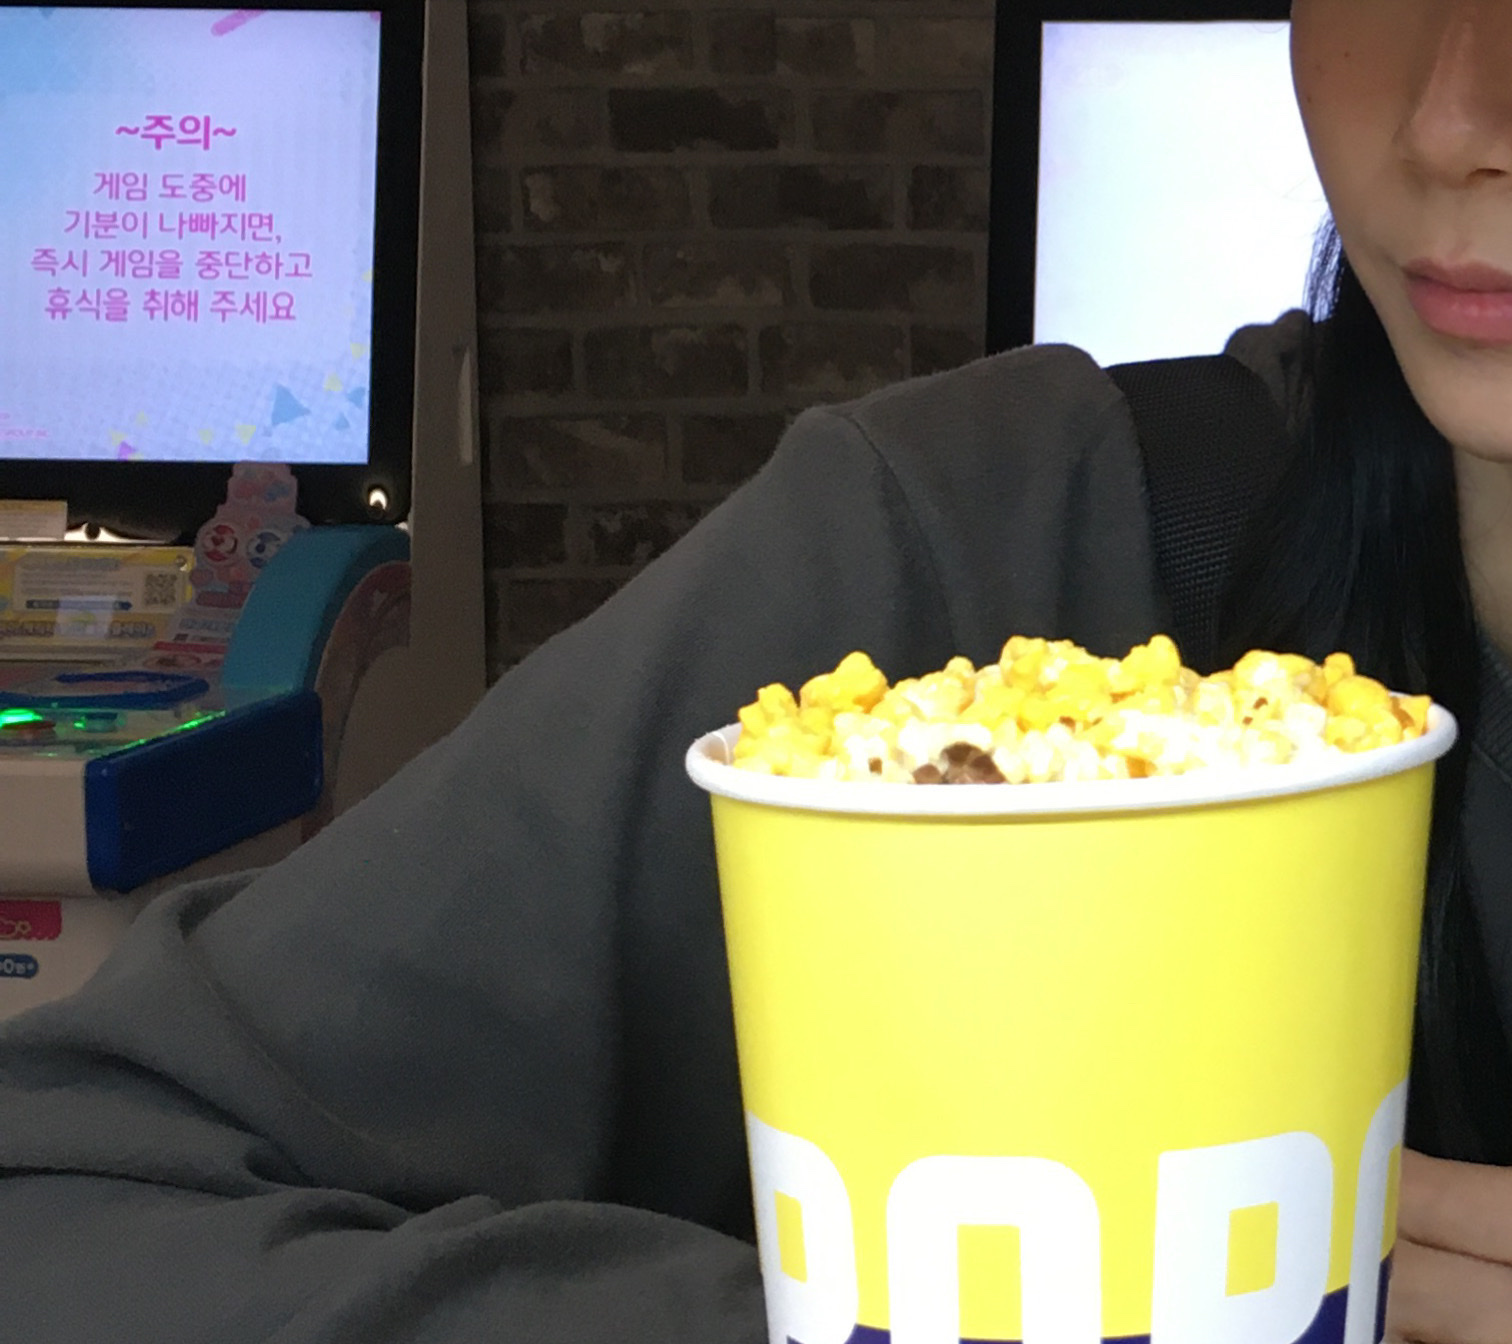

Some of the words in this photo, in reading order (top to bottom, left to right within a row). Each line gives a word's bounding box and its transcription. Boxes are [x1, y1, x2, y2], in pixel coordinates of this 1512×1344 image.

[115, 115, 237, 150] ~주의~
[93, 172, 148, 201] 게임
[159, 172, 247, 202] 도중에
[64, 211, 148, 240] 기분이
[158, 211, 282, 244] 나빠지면,
[30, 248, 88, 277] 즉시
[100, 249, 183, 280] 게임을
[195, 250, 313, 281] 중단하고
[45, 287, 130, 322] 휴식을
[143, 288, 199, 324] 취해
[210, 291, 297, 324] 주세요
